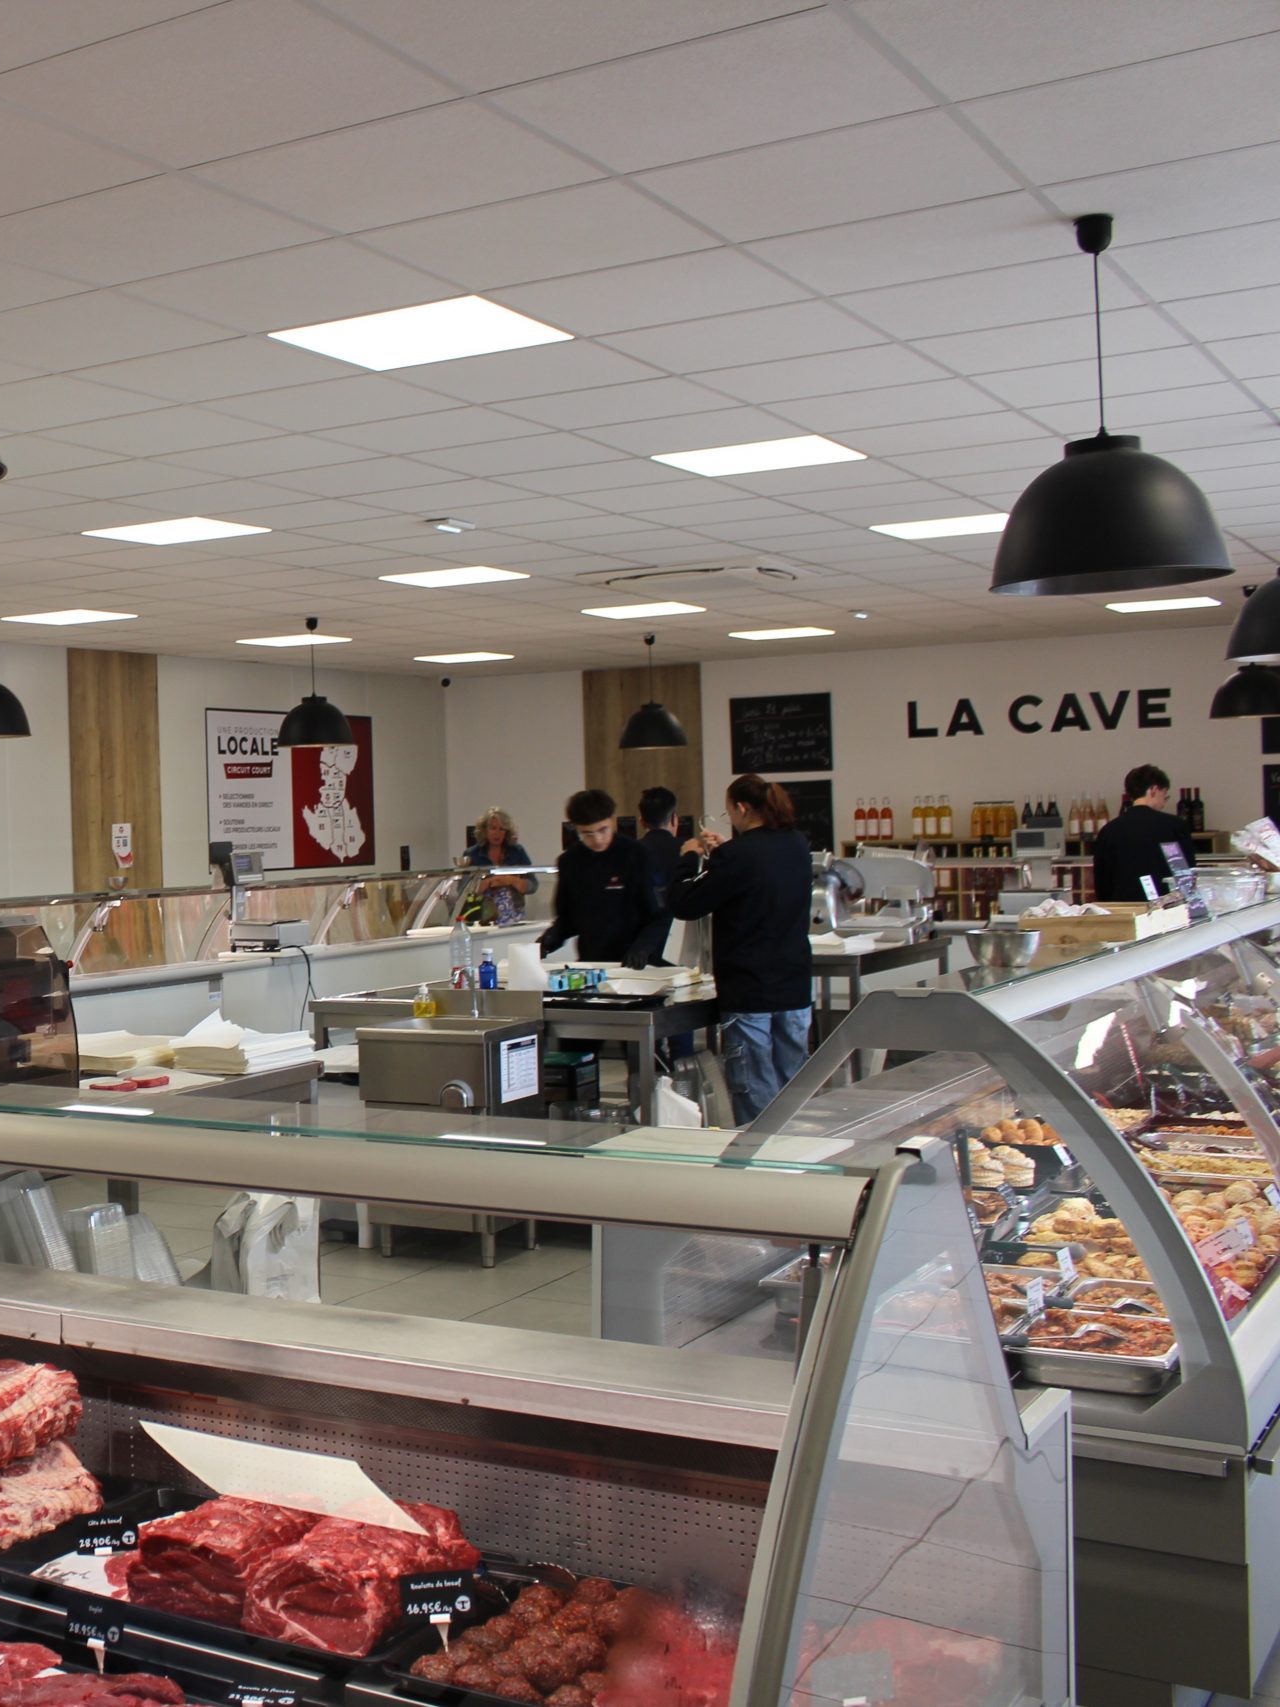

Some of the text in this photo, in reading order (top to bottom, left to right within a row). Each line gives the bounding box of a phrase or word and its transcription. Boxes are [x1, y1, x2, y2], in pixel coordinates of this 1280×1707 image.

[908, 688, 1172, 738] LA CAVE
[217, 735, 279, 756] LOCALE
[226, 766, 271, 774] CIRCUIT COURT
